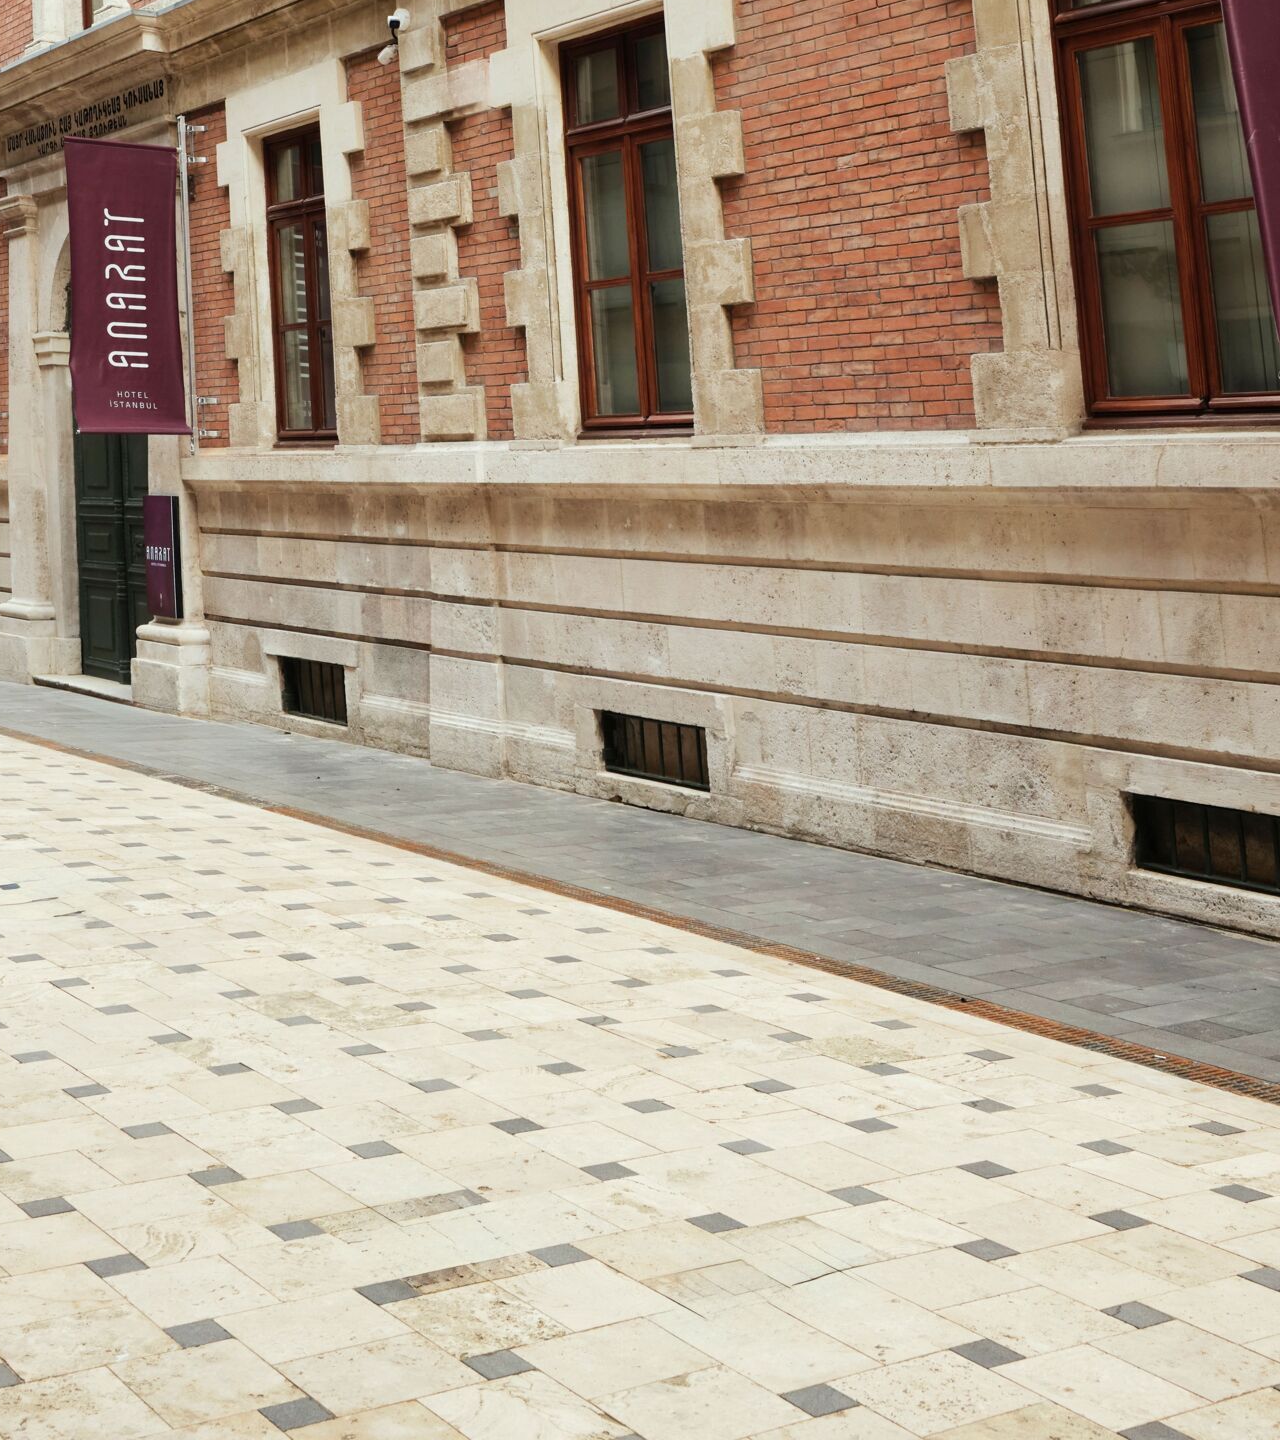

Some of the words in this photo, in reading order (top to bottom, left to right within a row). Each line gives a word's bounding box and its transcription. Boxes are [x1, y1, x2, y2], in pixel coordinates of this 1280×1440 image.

[103, 207, 150, 369] ANARAT
[116, 390, 149, 399] HOTEL
[145, 545, 171, 562] ANARAT
